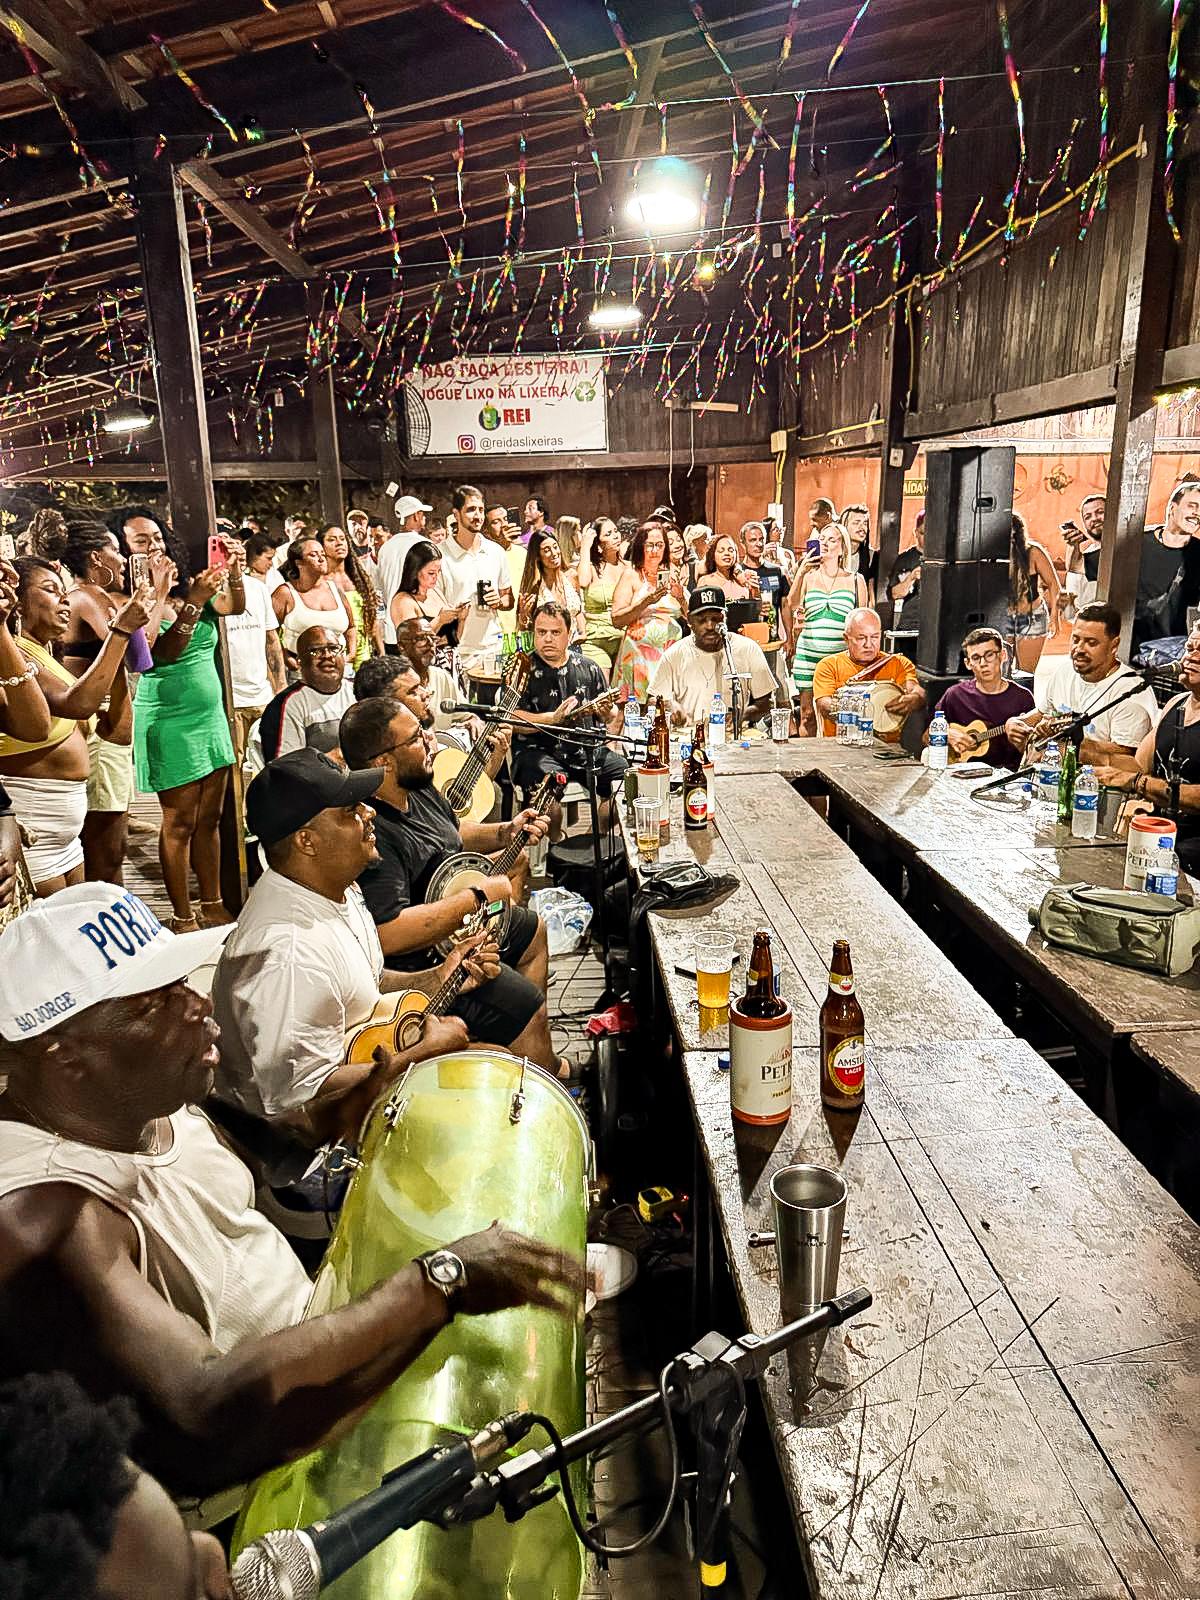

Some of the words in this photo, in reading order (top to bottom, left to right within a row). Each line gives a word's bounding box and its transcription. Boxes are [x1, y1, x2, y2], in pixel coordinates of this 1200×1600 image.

[421, 387, 462, 401] JOGUE
[465, 387, 494, 400] LIXO
[498, 386, 516, 399] NA
[520, 385, 569, 399] LIXEIRA
[503, 408, 531, 423] REI
[479, 436, 564, 451] @reidaslixeiras
[1127, 851, 1160, 868] PETRA
[34, 991, 77, 1023] JORGE
